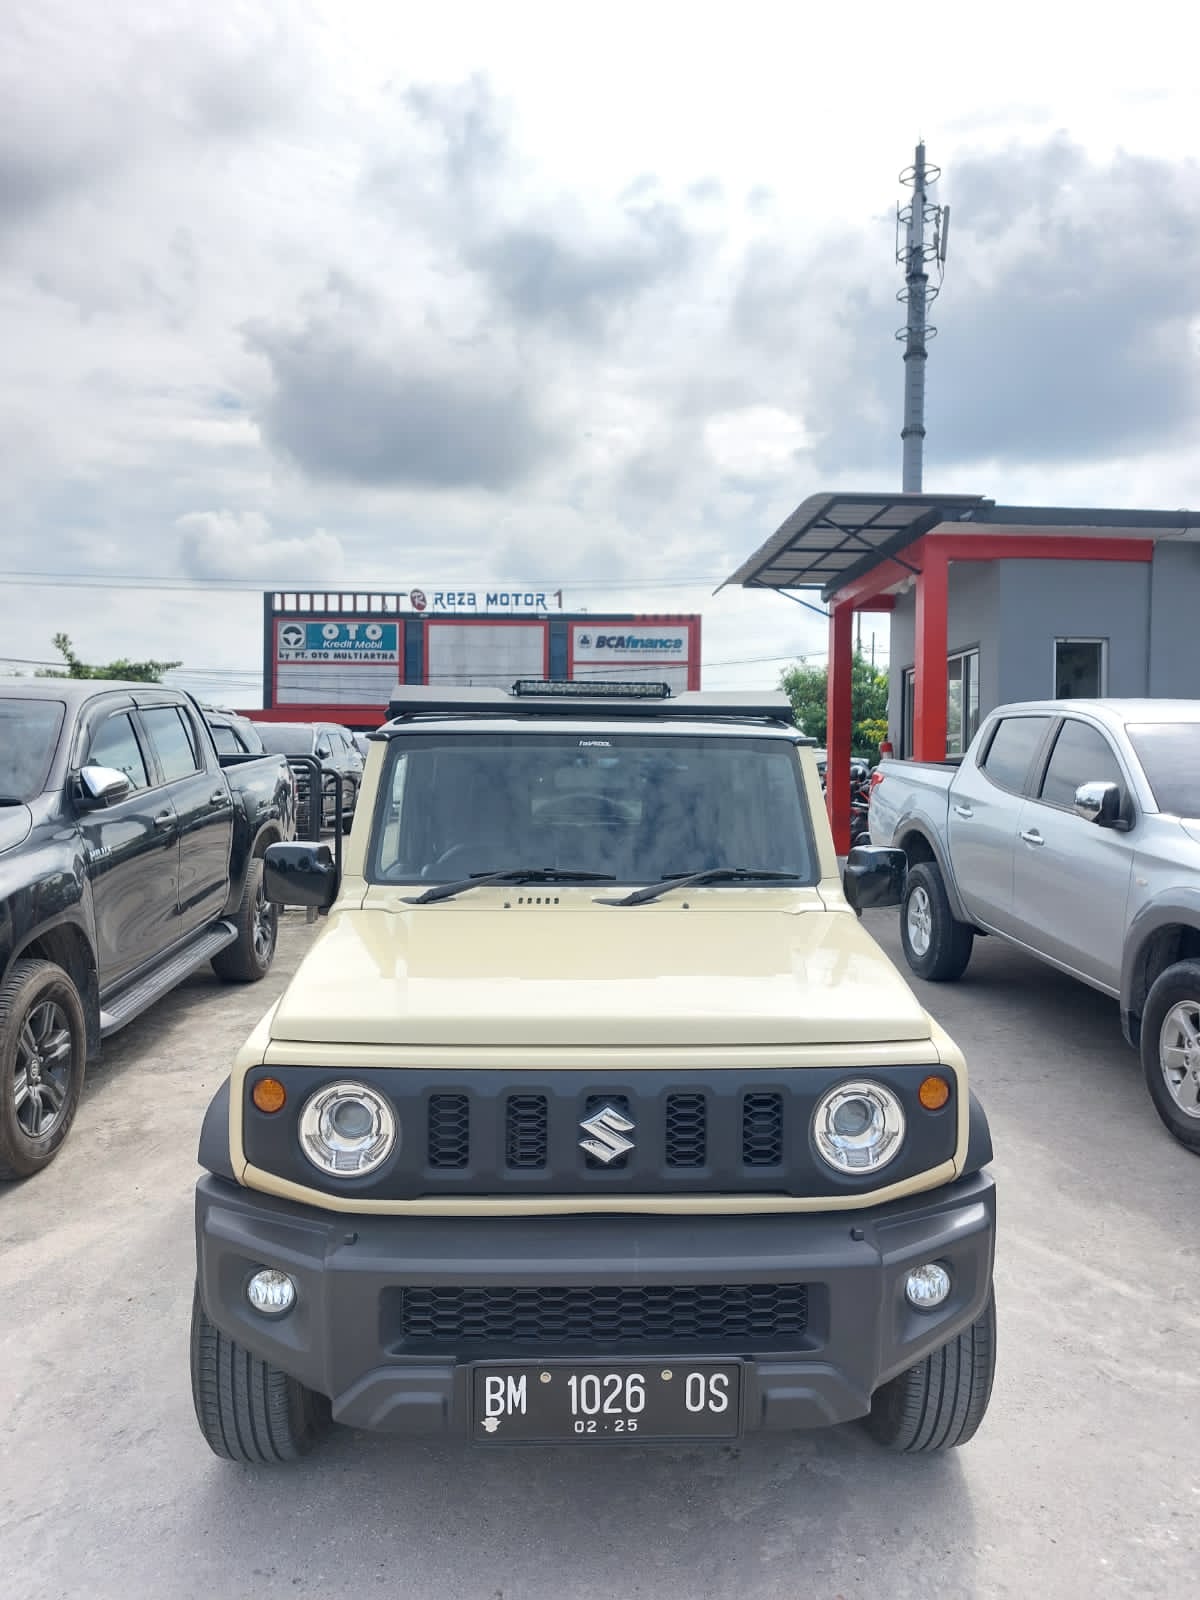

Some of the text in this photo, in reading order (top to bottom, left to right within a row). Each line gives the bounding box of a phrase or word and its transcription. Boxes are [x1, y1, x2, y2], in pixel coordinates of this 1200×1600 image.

[486, 592, 548, 610] MOTOR
[553, 589, 563, 609] 1
[322, 623, 383, 640] OTO
[322, 639, 383, 649] Kredit Mobil
[595, 635, 683, 649] BCAfinance
[279, 651, 290, 660] by
[311, 651, 329, 660] OTO
[485, 1372, 729, 1416] BM 1026 OS
